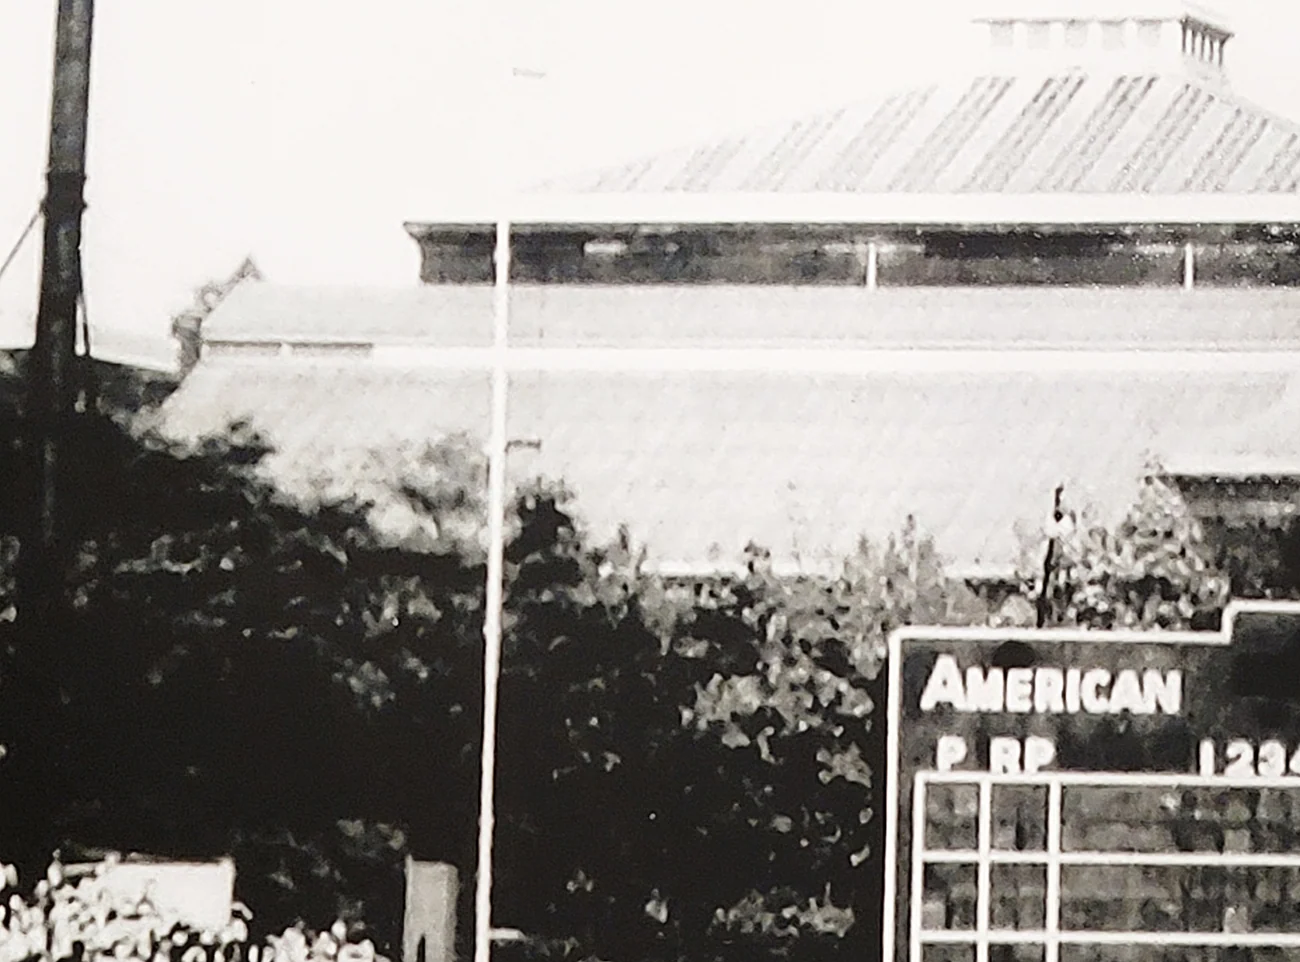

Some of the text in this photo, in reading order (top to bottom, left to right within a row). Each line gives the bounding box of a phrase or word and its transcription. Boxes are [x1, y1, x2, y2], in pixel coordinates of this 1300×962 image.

[919, 653, 1183, 715] AMERICAN
[936, 734, 968, 773] P
[989, 735, 1056, 773] RP
